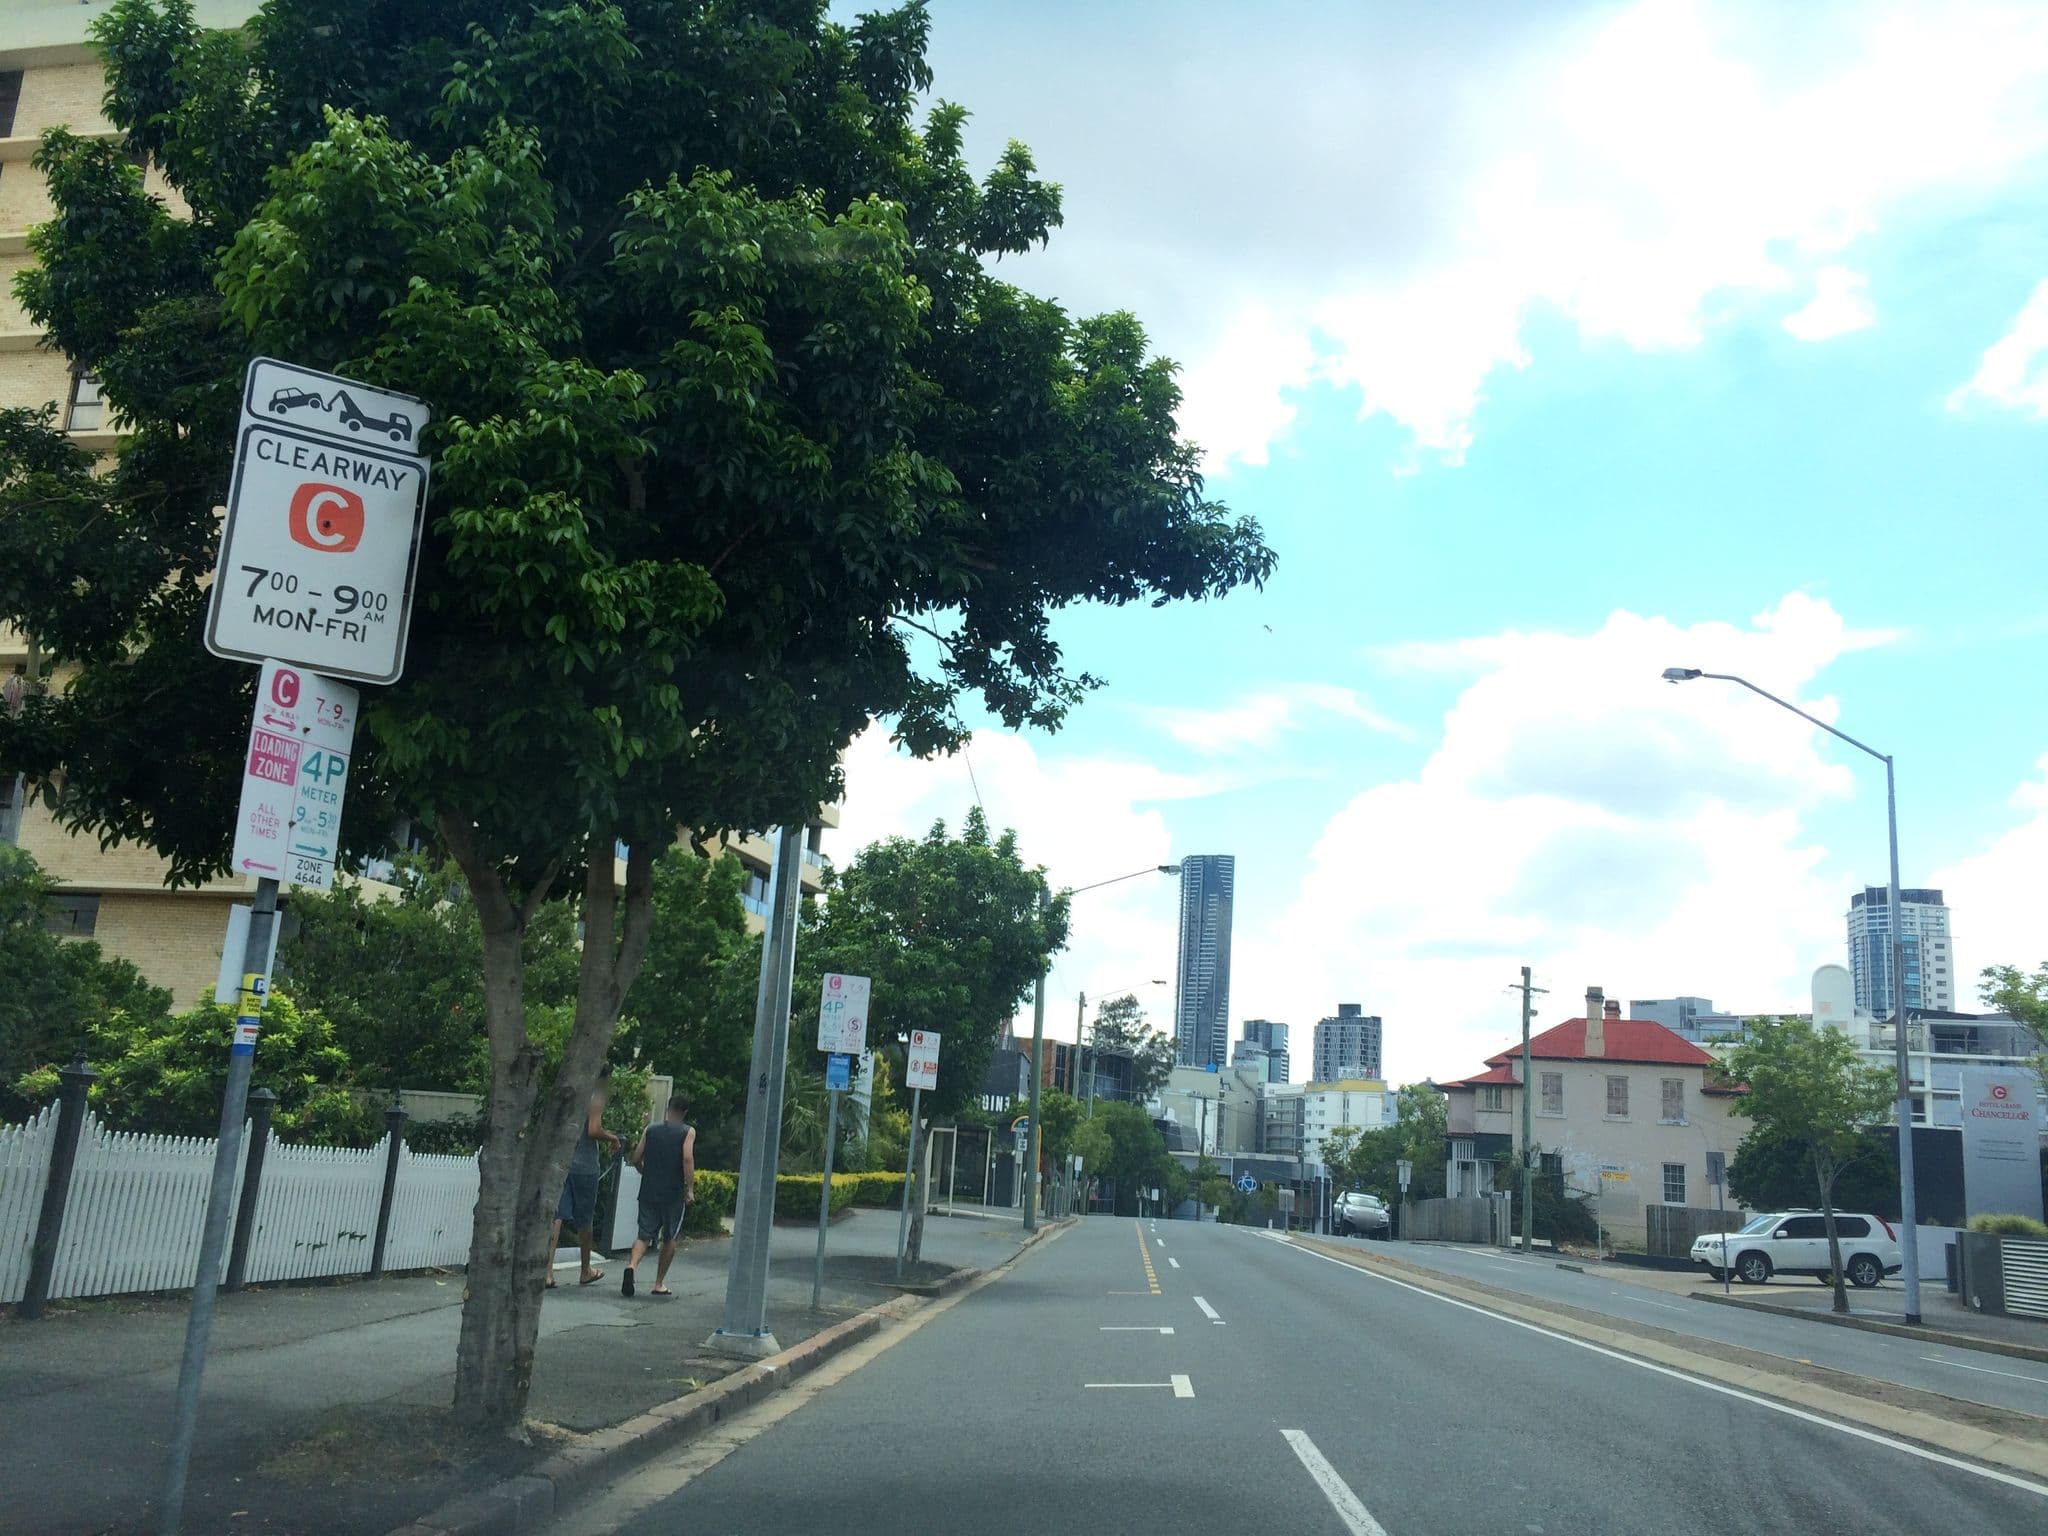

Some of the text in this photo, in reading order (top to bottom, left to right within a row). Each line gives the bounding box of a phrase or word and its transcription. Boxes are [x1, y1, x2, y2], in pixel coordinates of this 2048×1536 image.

[257, 438, 407, 491] CLEARWAY
[306, 491, 349, 546] C
[253, 604, 367, 643] MON-FRI
[364, 611, 384, 624] AM
[278, 673, 295, 703] C
[254, 736, 299, 762] LOADING
[255, 757, 290, 783] ZONE
[302, 750, 345, 785] 4P
[301, 785, 337, 805] METER
[258, 803, 276, 816] ALL
[250, 813, 280, 829] OTHER
[250, 825, 277, 840] TIMES
[297, 859, 323, 875] ZONE
[294, 871, 322, 886] 4644
[823, 1001, 844, 1013] 4P
[1971, 1108, 2029, 1121] CHANCELLOR
